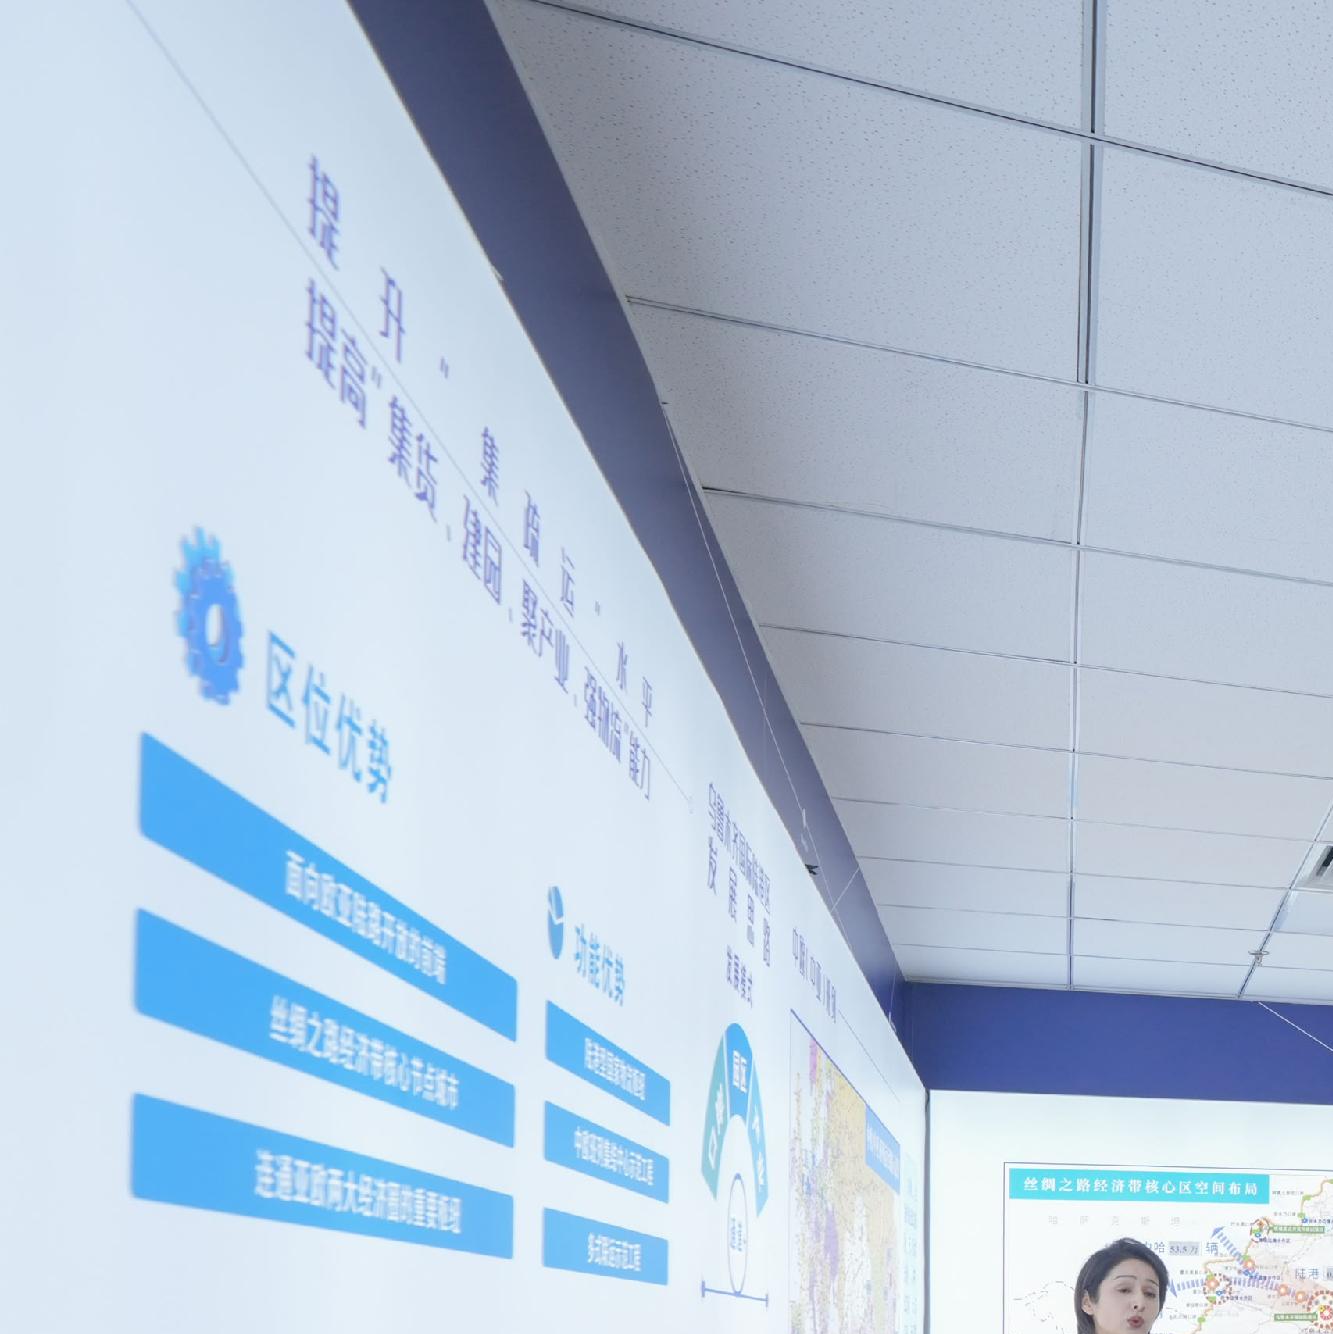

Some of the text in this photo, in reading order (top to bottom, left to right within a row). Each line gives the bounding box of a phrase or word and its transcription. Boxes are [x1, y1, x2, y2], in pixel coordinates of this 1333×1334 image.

[266, 630, 391, 803] 区位优势
[574, 923, 626, 1006] 功能优势
[1023, 1177, 1258, 1197] 丝绸之路经济带核心区空间布局
[1295, 1268, 1320, 1280] 陆港
